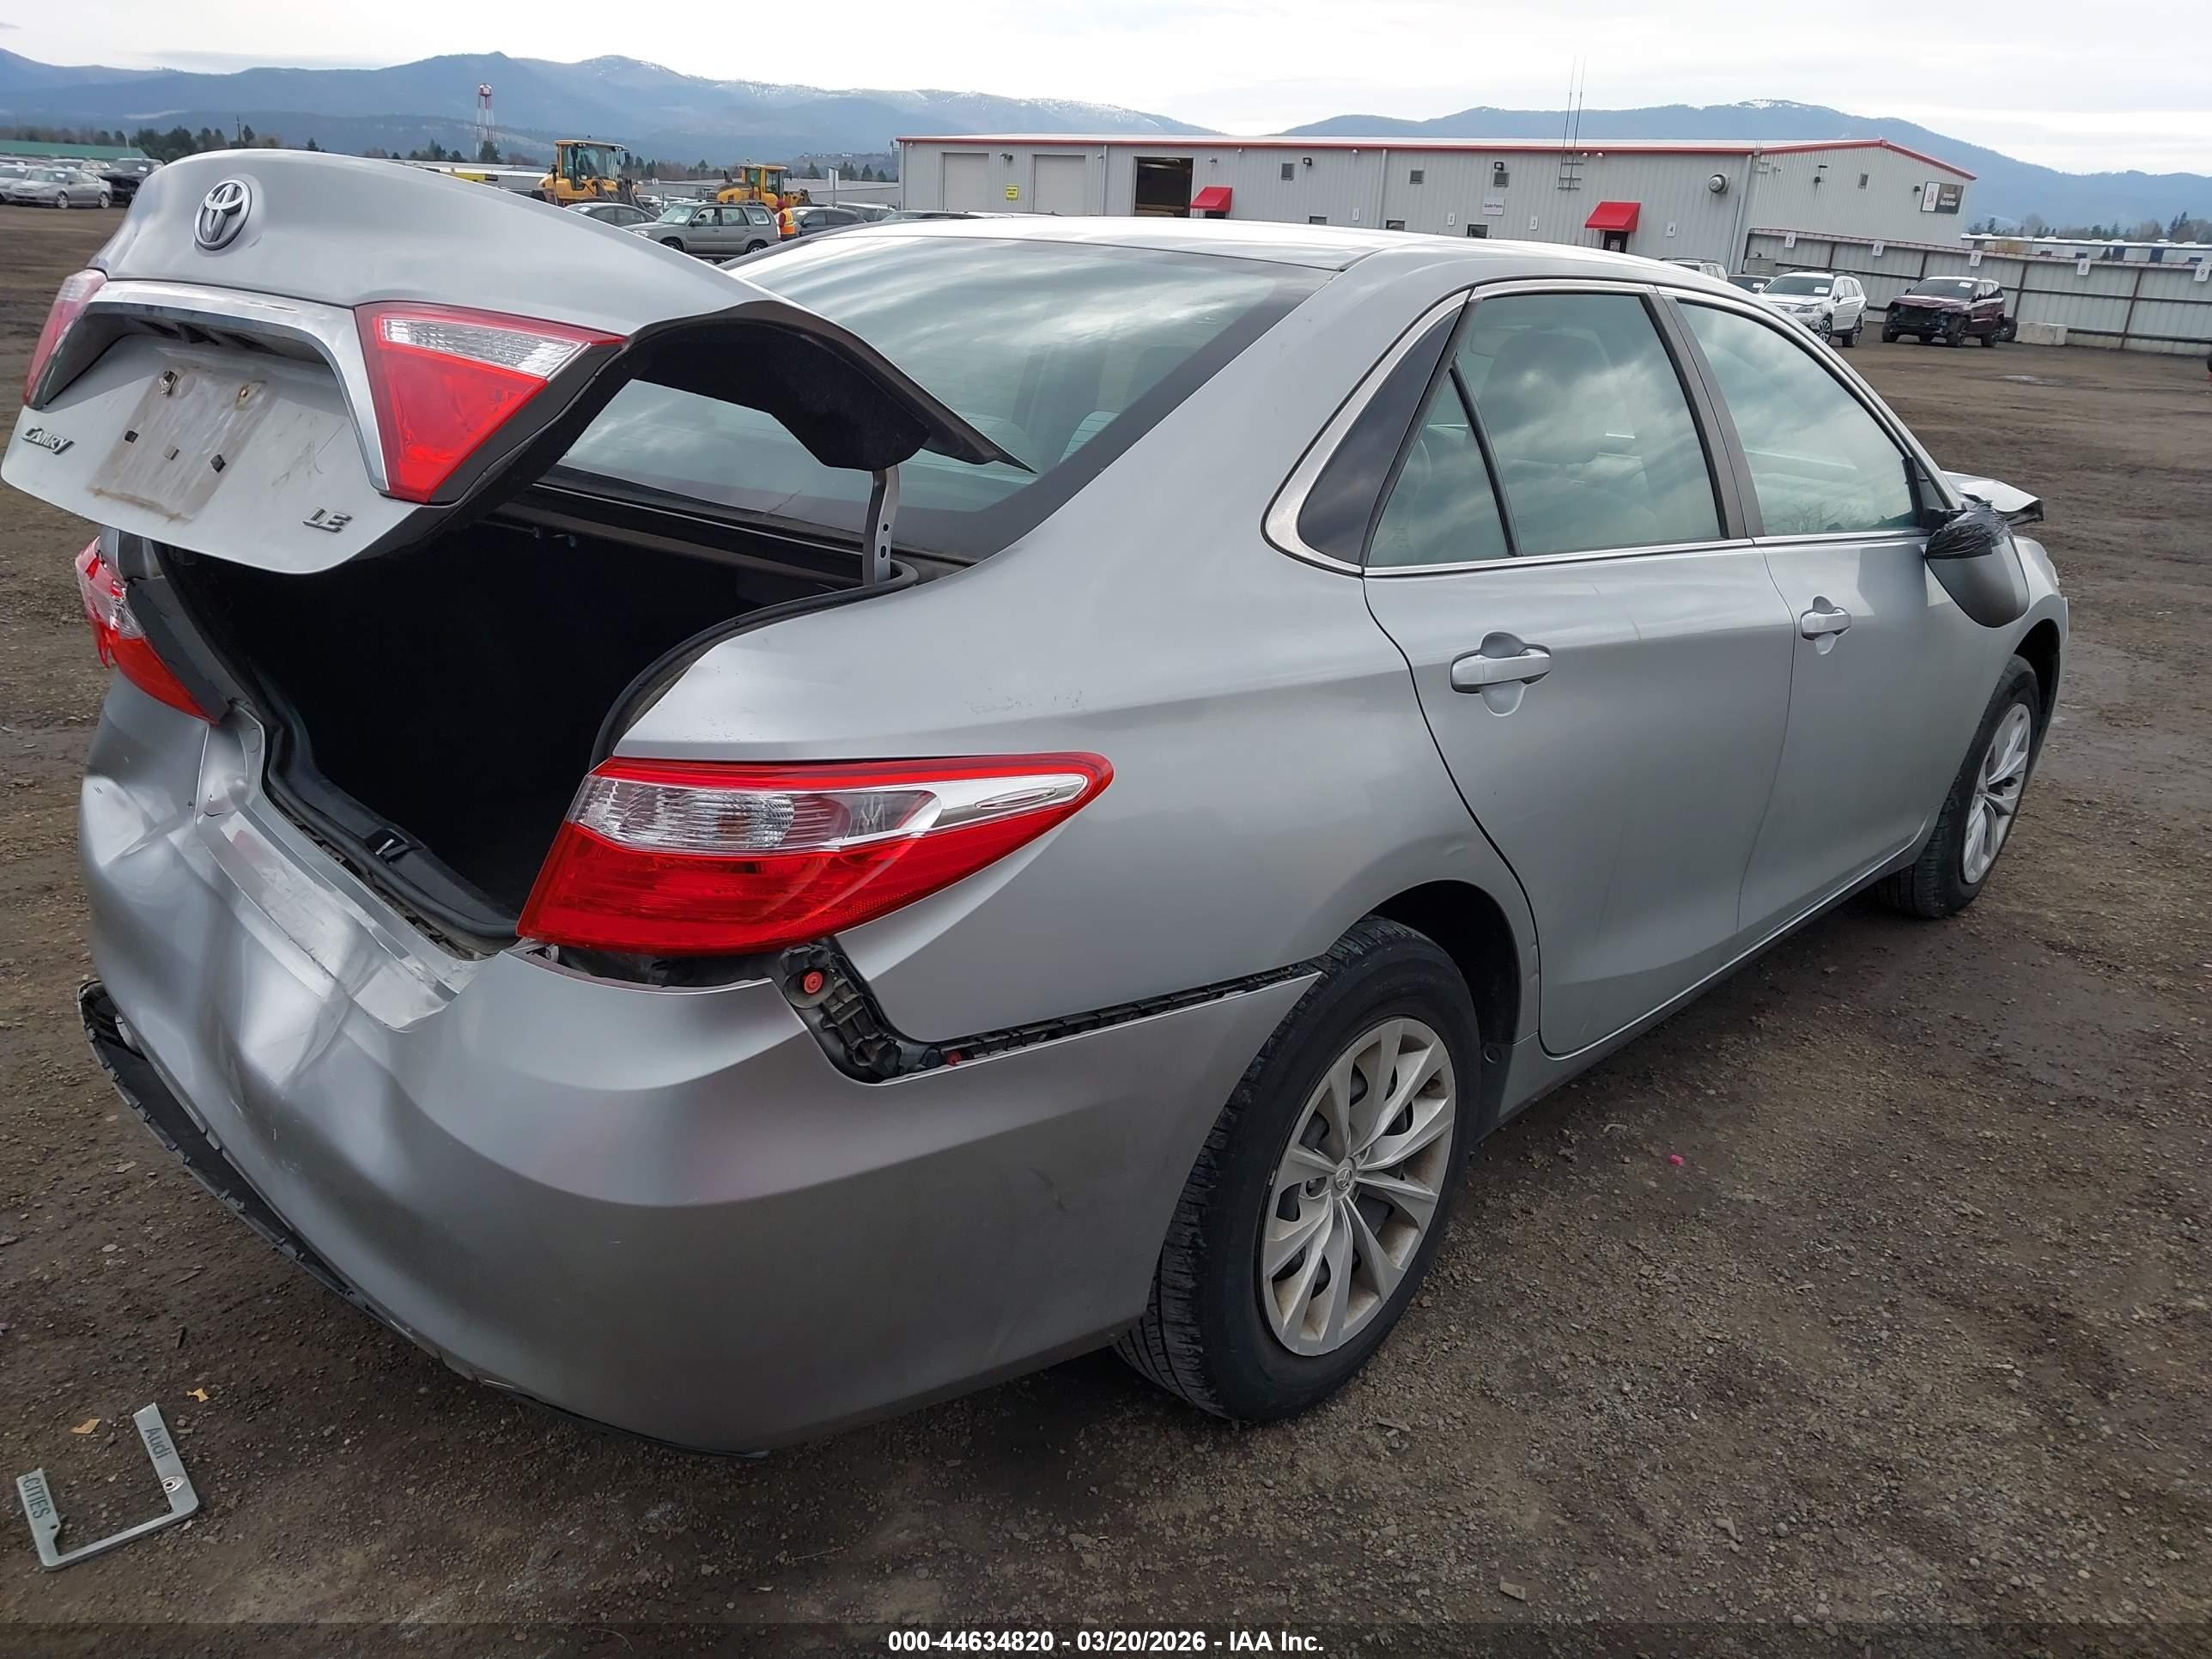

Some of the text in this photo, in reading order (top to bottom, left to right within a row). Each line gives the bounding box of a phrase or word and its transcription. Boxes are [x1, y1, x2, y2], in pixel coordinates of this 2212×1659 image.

[21, 428, 75, 455] CAMRY
[302, 508, 353, 533] LE
[143, 1427, 173, 1459] Audi
